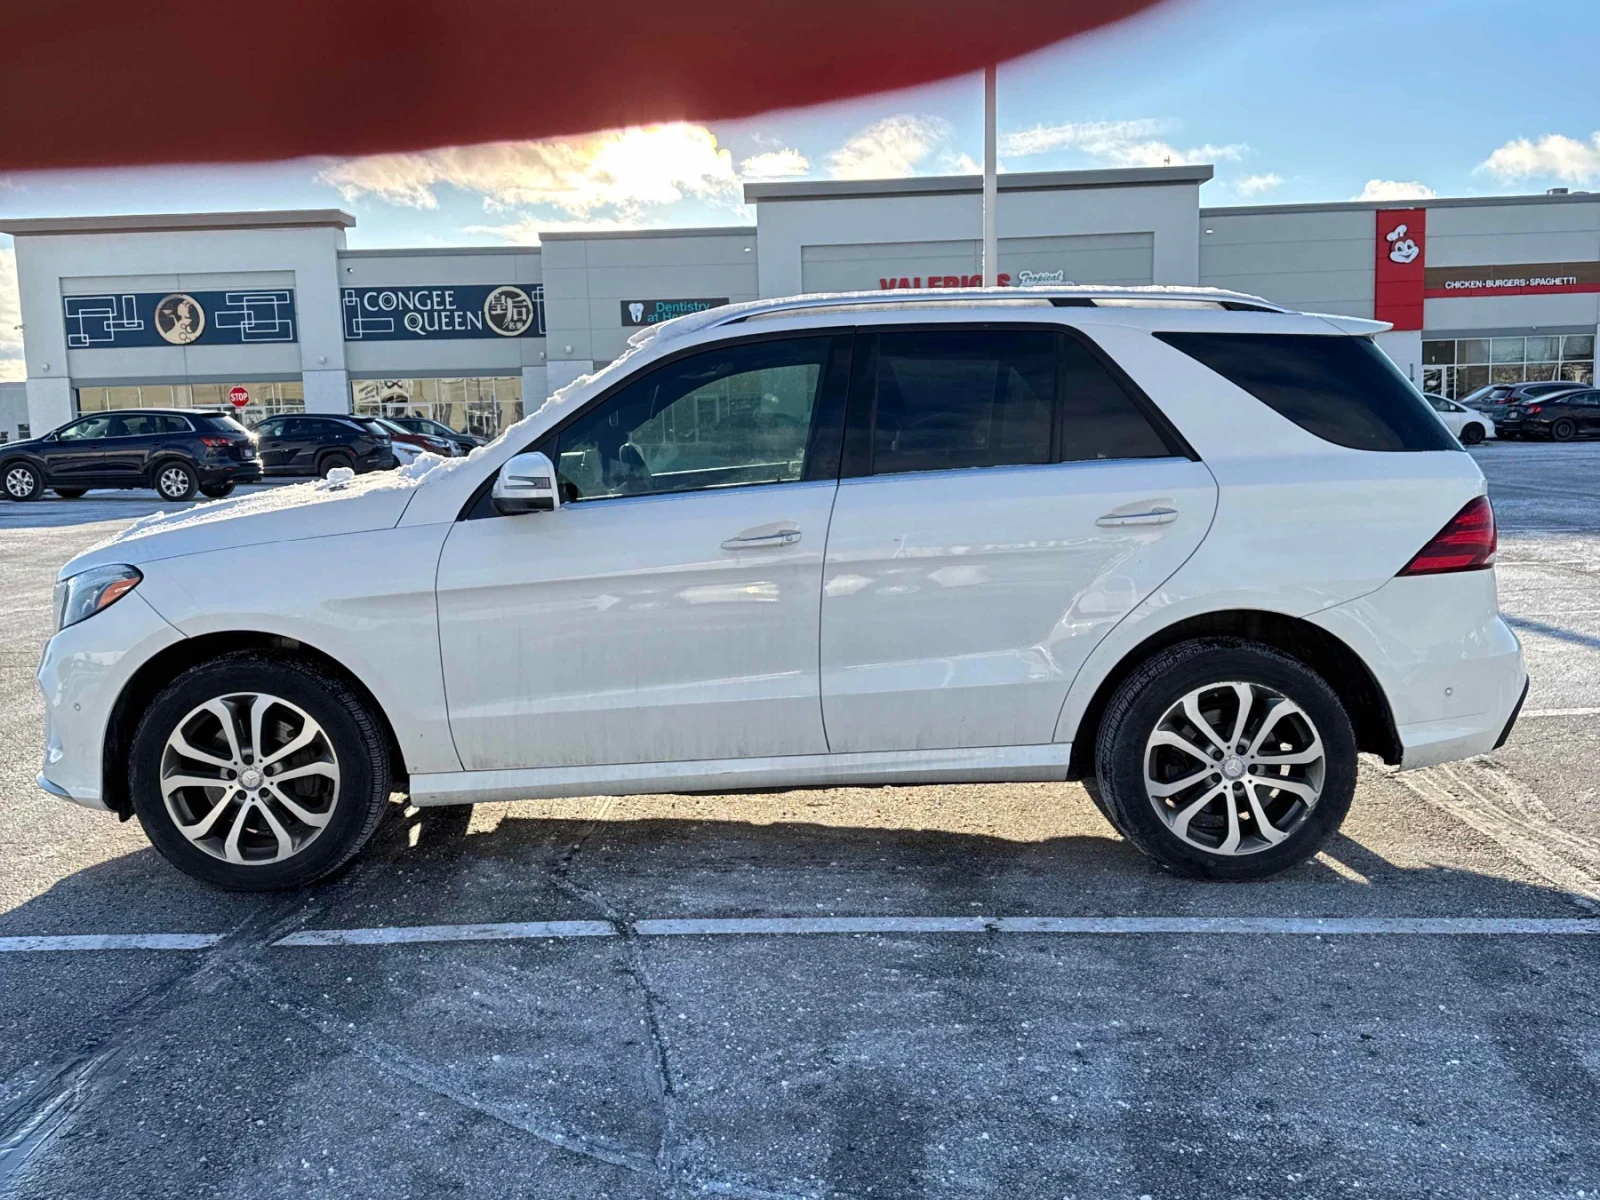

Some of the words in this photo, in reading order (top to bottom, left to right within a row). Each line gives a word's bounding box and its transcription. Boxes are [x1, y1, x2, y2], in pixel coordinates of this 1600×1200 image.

[1020, 271, 1062, 284] Tropical
[1445, 280, 1482, 289] CHICKEN
[1486, 278, 1525, 287] BURGERS
[1530, 276, 1577, 286] SPAGHETTI
[363, 290, 457, 312] CONGEE
[655, 301, 710, 312] Dentistry
[403, 311, 483, 336] QUEEN
[647, 313, 659, 323] at
[230, 392, 248, 402] STOP
